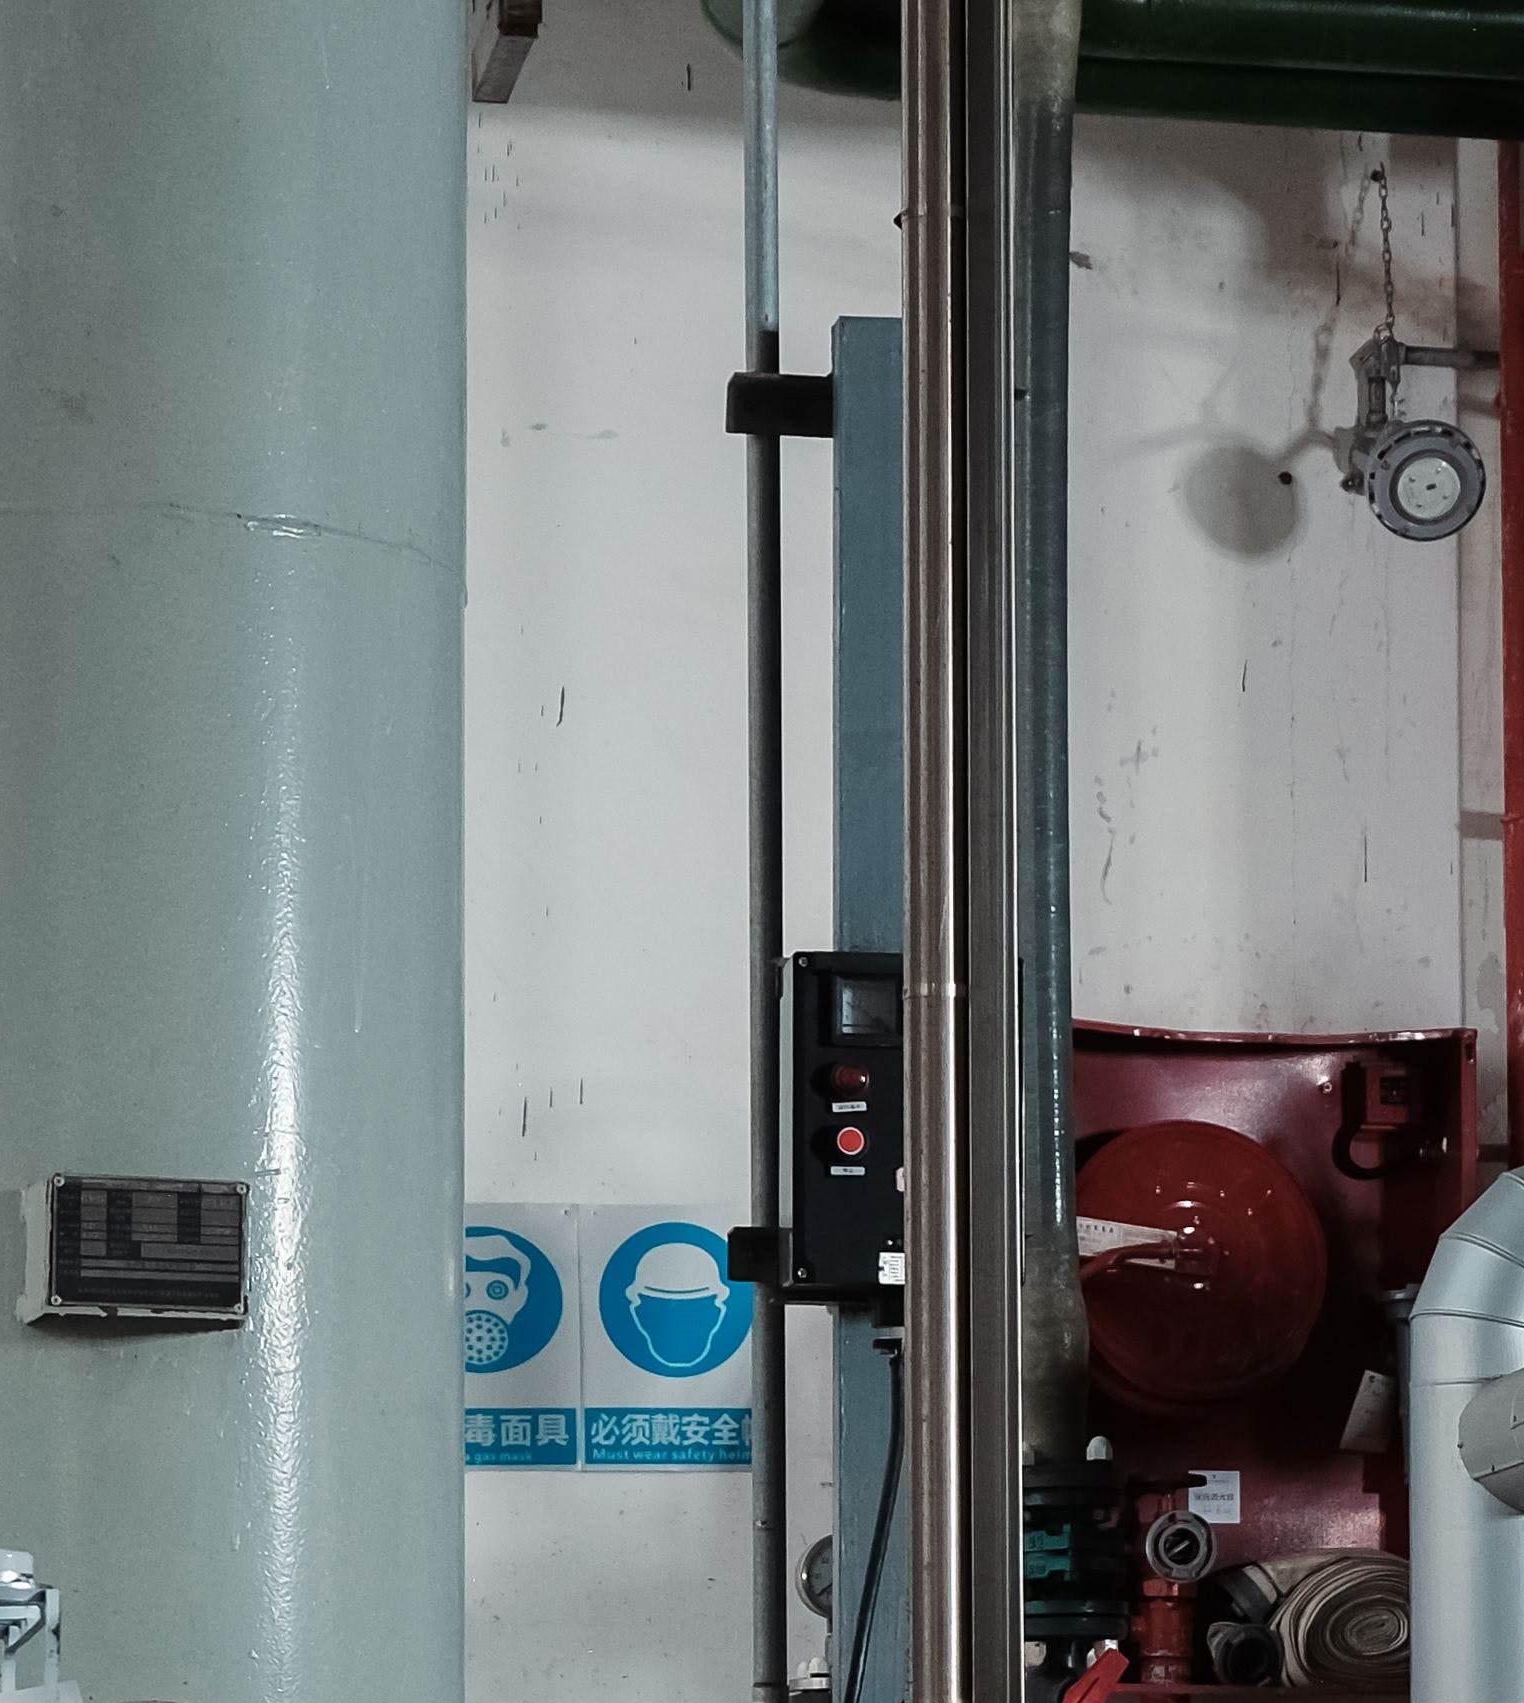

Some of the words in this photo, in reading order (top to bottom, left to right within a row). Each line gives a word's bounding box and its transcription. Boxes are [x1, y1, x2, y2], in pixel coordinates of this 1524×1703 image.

[592, 1448, 629, 1460] Must
[633, 1450, 669, 1460] wear
[672, 1447, 715, 1462] safety
